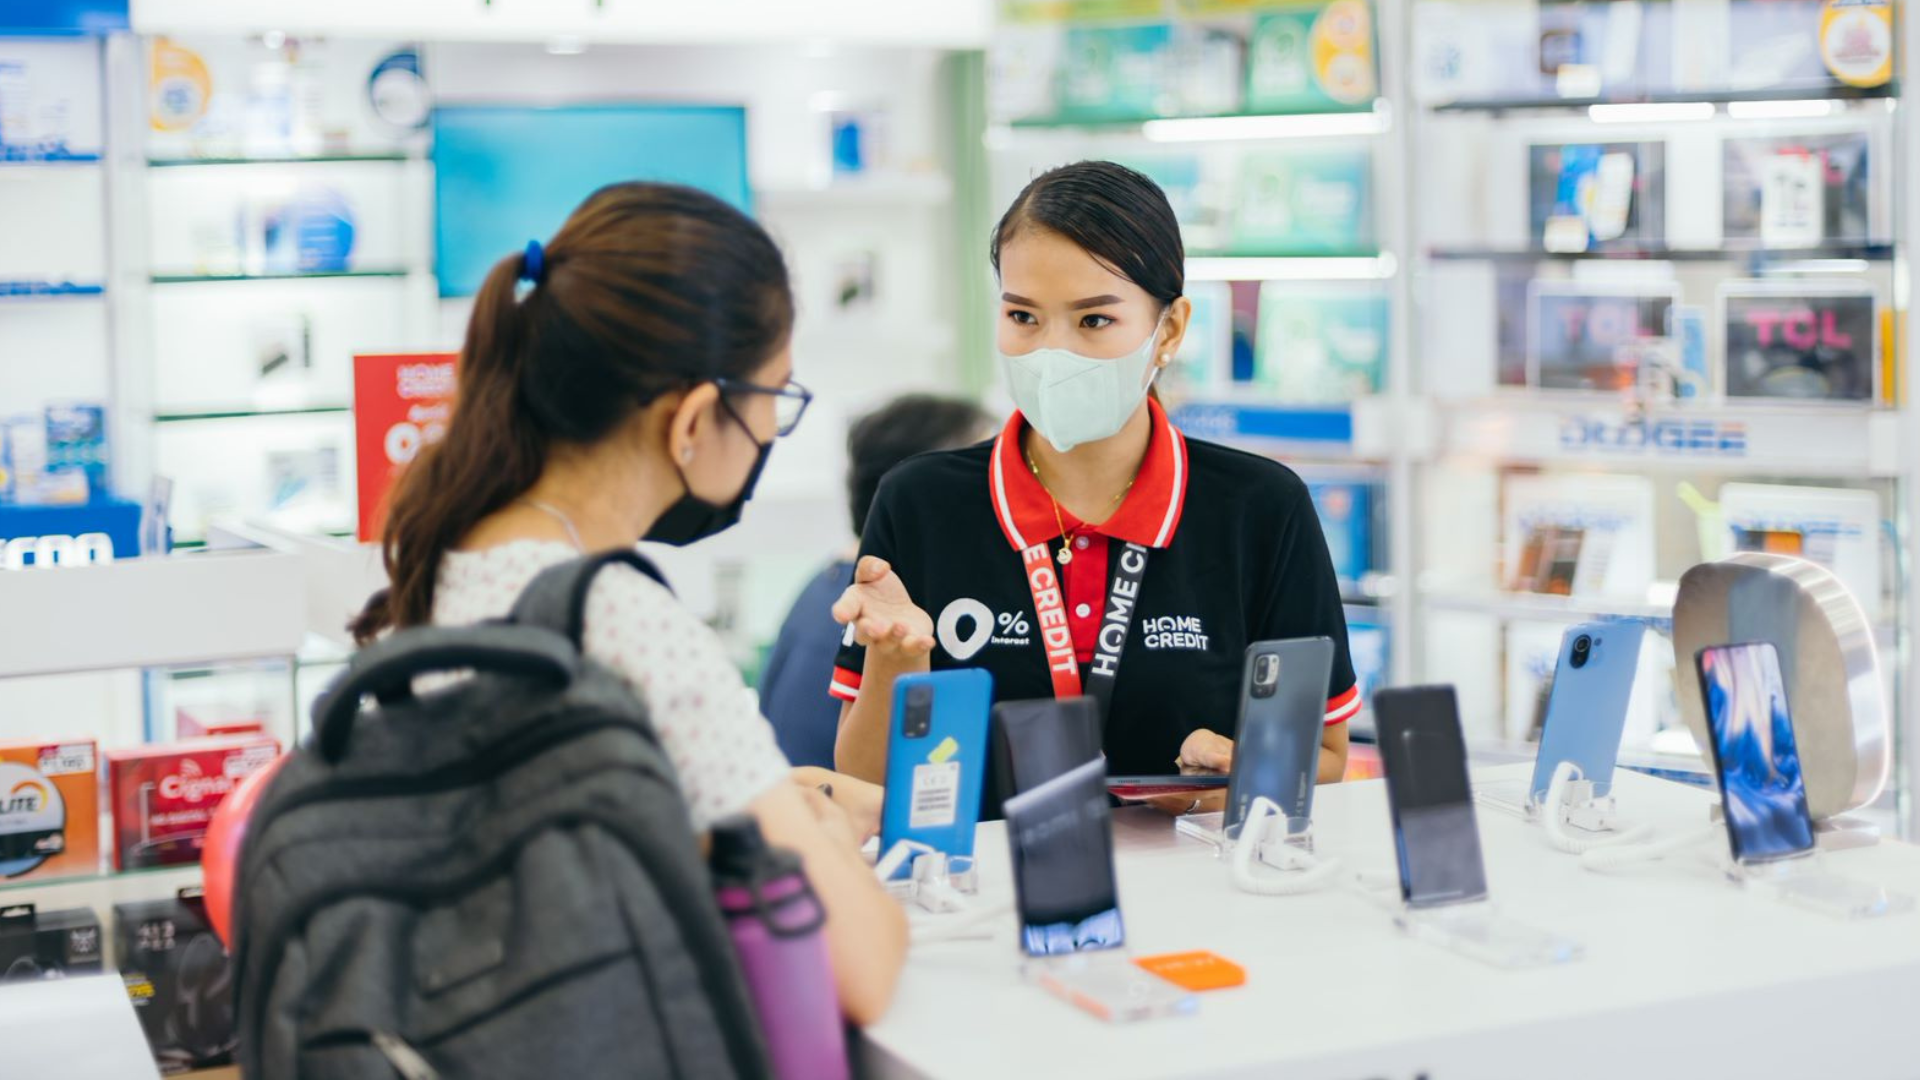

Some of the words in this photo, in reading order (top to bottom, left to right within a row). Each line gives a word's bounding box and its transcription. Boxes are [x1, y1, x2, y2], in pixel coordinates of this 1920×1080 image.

[1746, 307, 1852, 351] TCL
[1031, 567, 1077, 675] CREDIT
[1091, 577, 1138, 676] HOME
[1143, 616, 1201, 634] HOME
[1144, 632, 1209, 650] CREDIT
